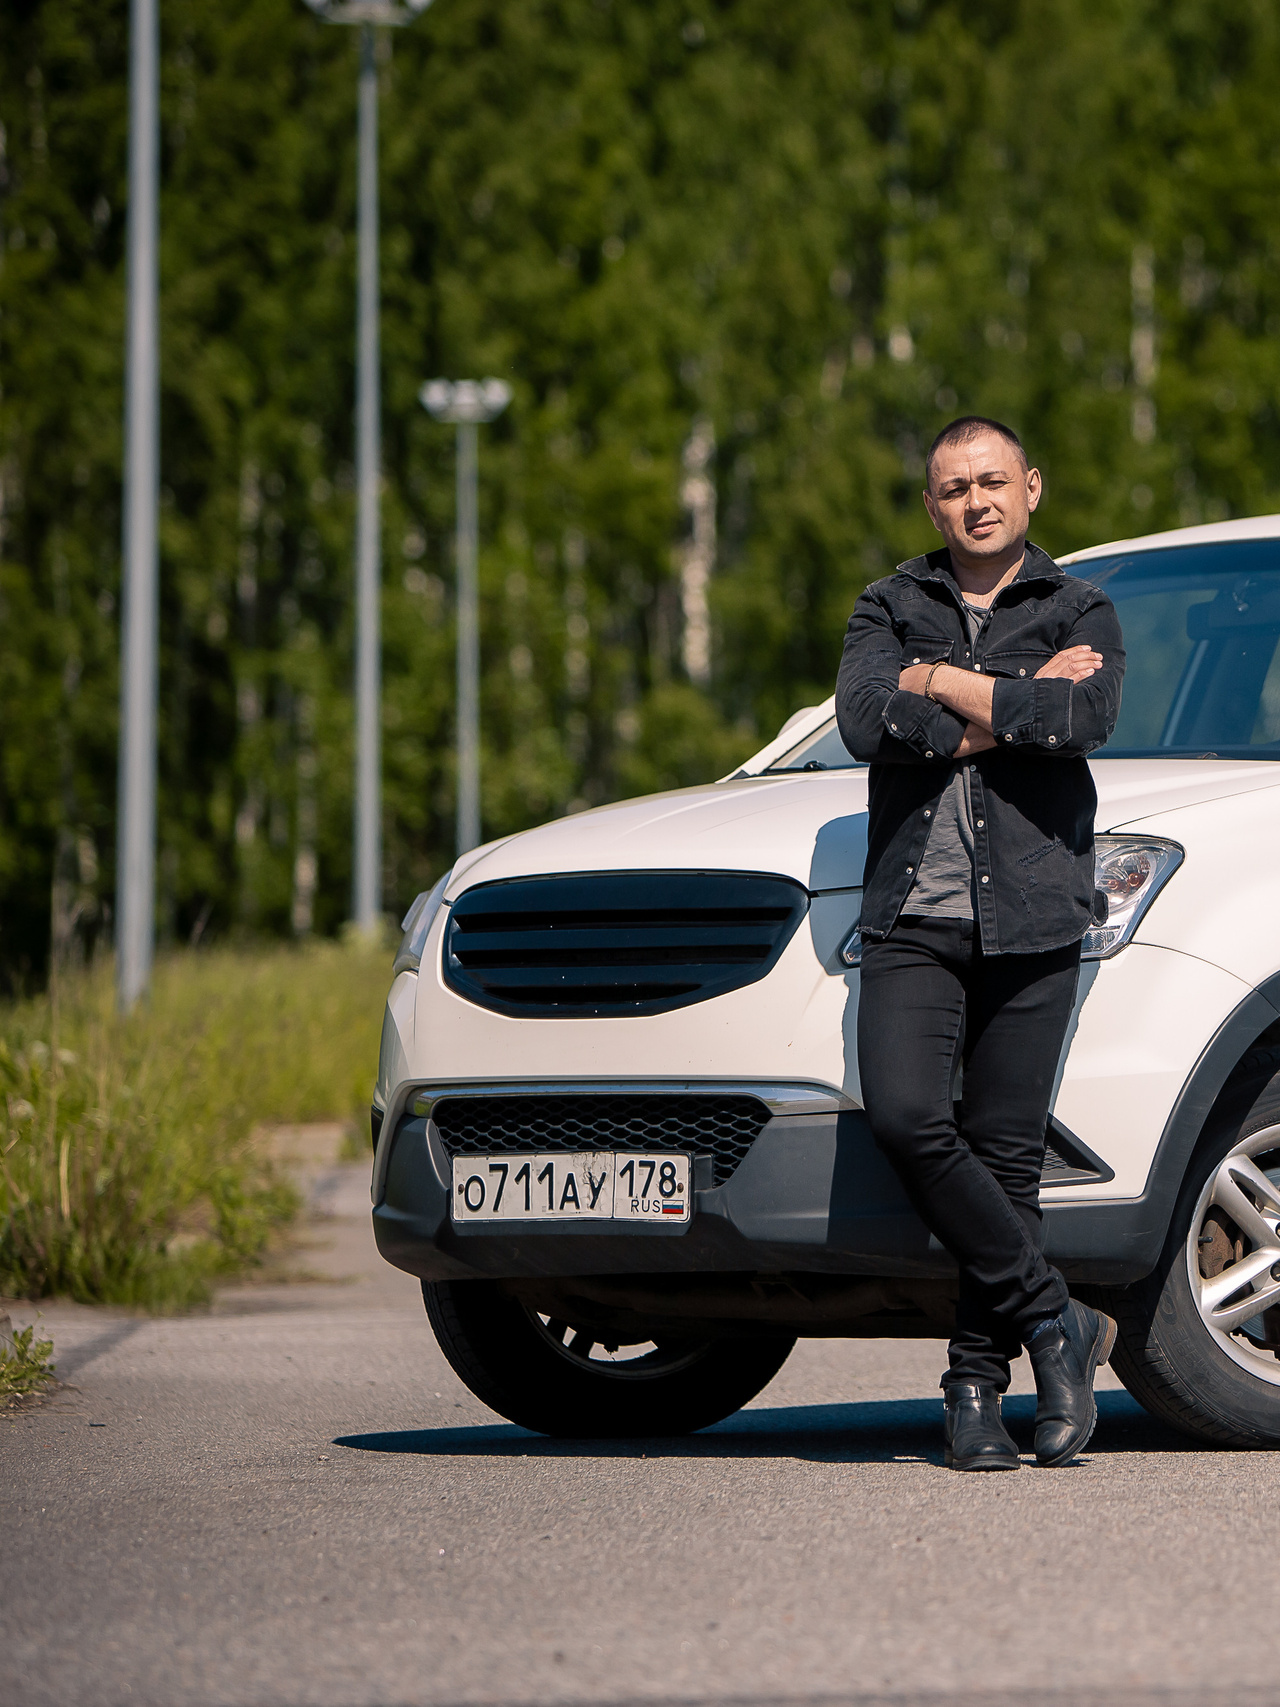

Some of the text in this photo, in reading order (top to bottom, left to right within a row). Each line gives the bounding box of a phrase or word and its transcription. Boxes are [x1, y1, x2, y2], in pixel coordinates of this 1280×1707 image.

[464, 1159, 677, 1213] О711АУ 178
[630, 1199, 661, 1213] RUS
